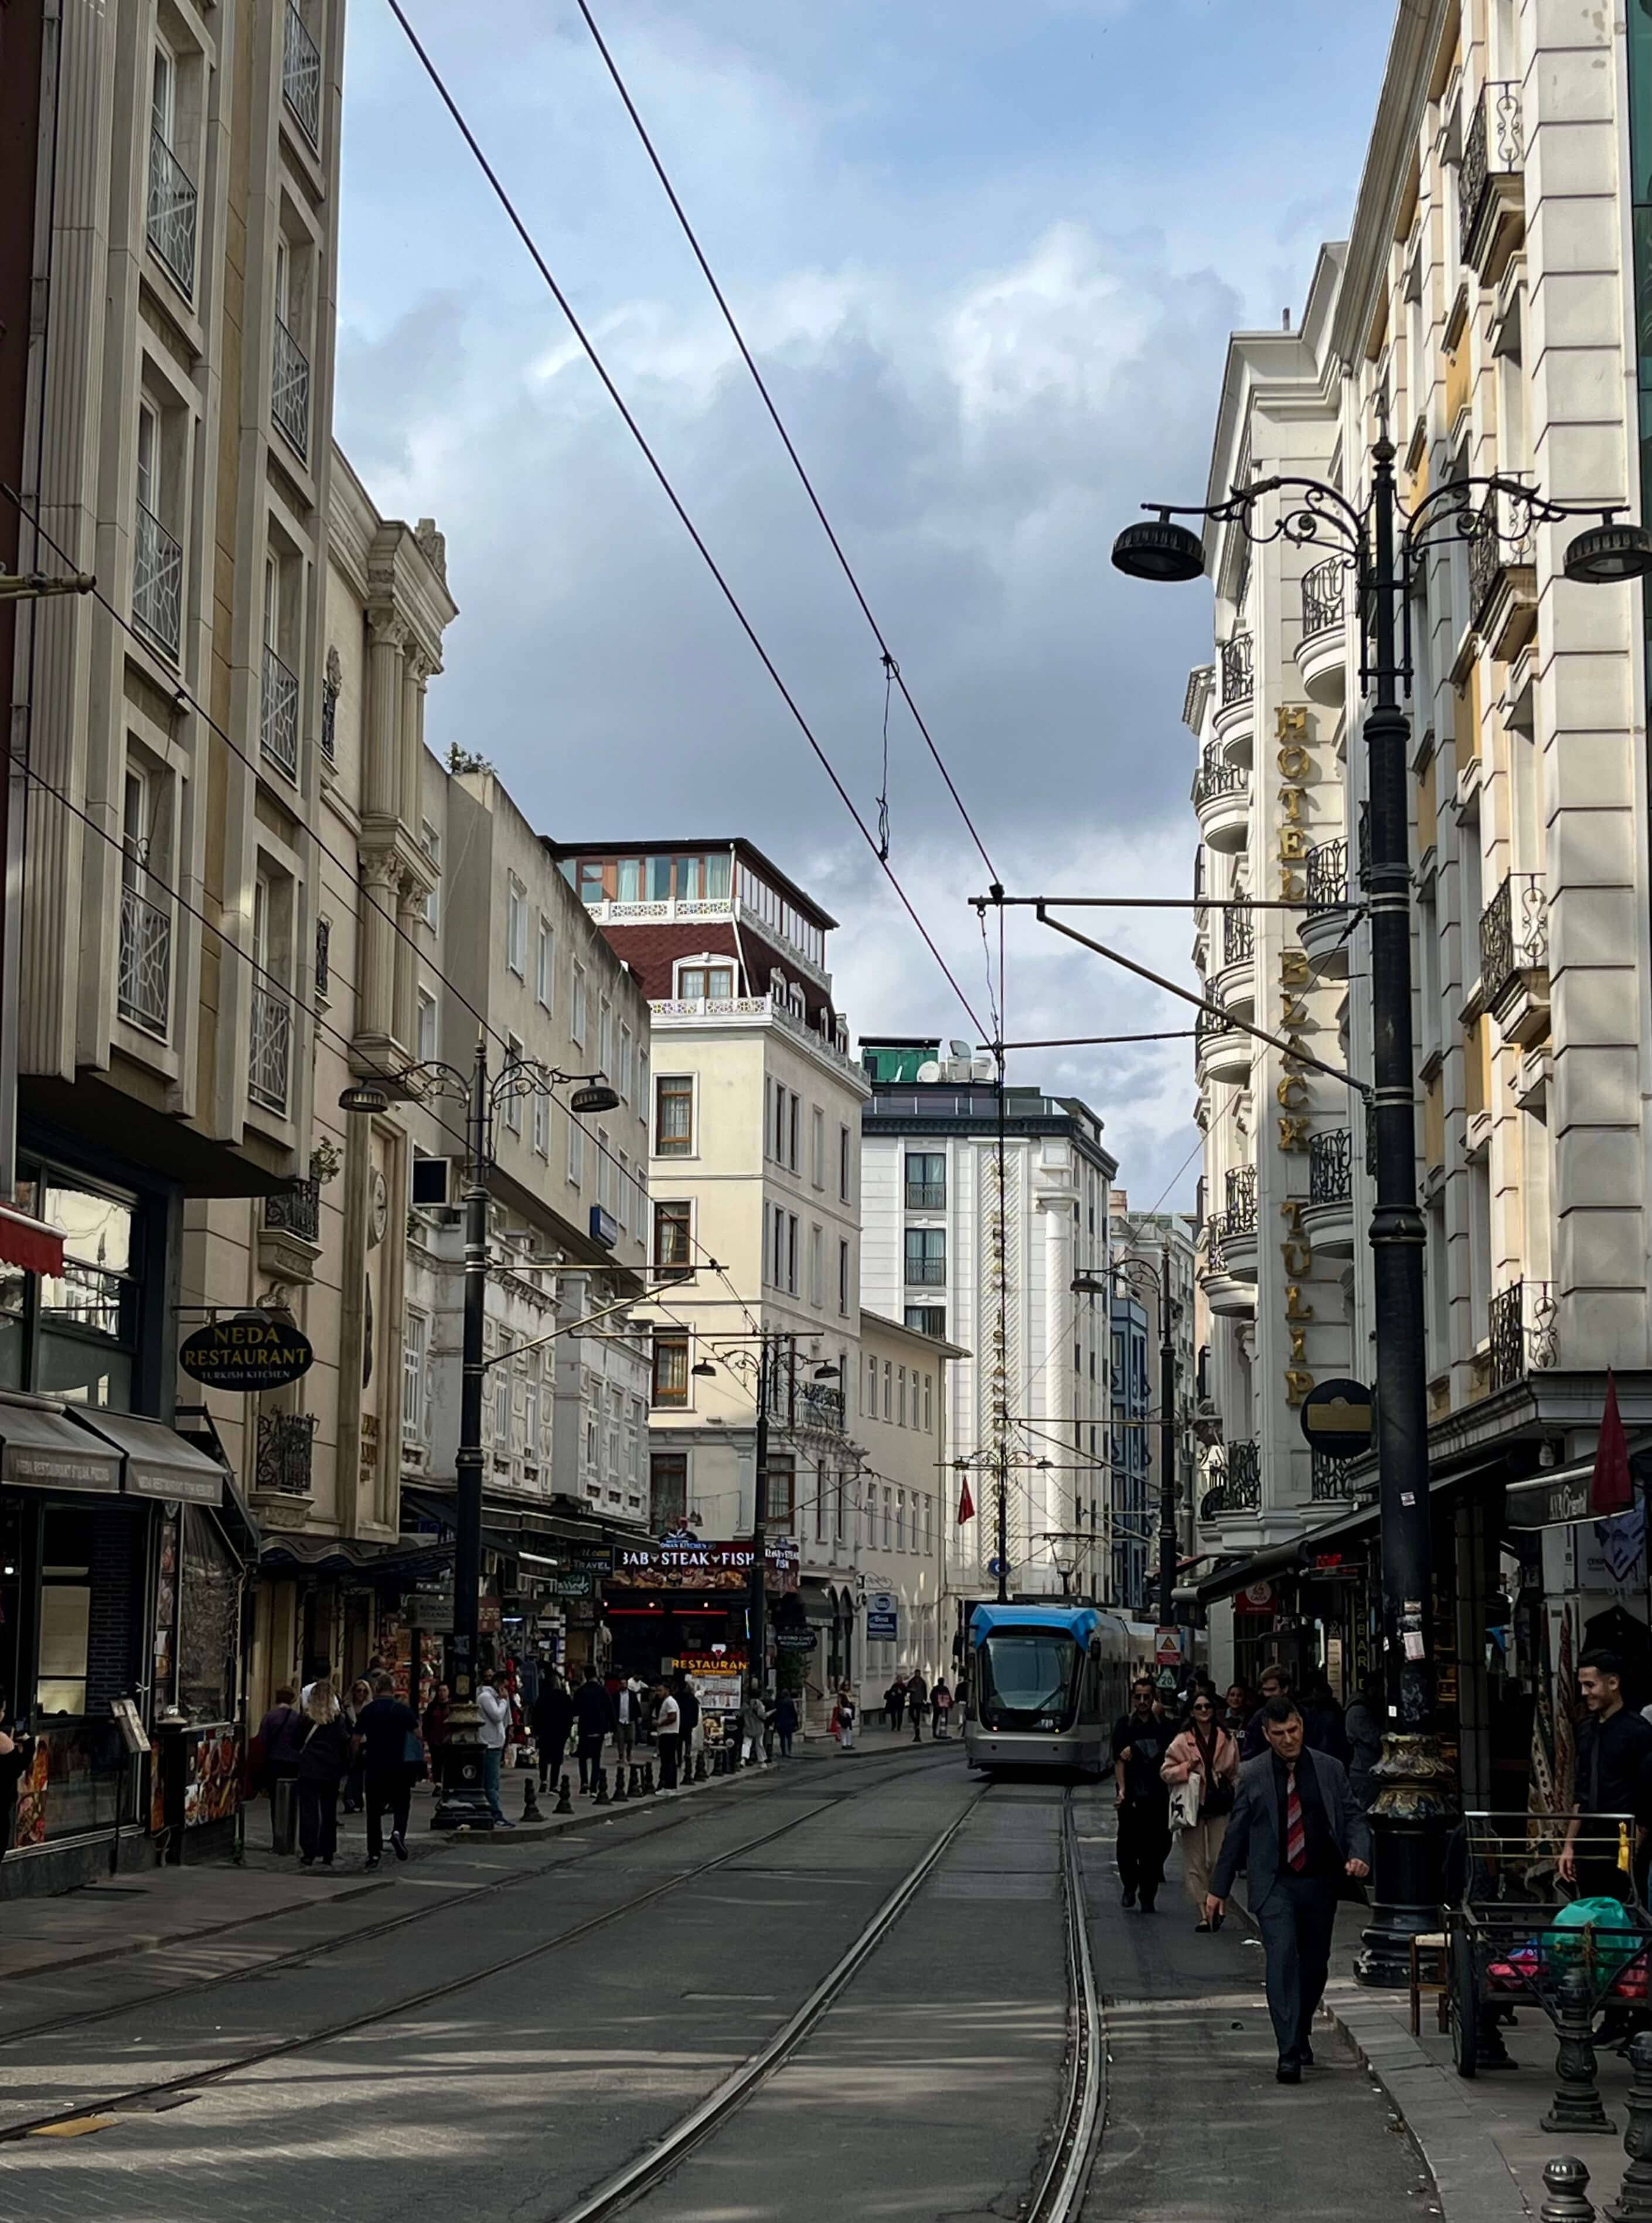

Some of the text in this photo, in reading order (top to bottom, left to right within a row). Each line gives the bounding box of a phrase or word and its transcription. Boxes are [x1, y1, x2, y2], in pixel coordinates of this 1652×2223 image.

[1274, 706, 1311, 902] HOTEL
[1276, 951, 1312, 1152] BLACK
[1280, 1201, 1314, 1405] TULIP
[214, 1326, 281, 1345] NEDA
[185, 1348, 307, 1366] RESTAURANT
[201, 1370, 291, 1380] TURKISH KITCHEN
[573, 1559, 611, 1571] TRAVEL
[661, 1552, 710, 1565] STEAK
[721, 1552, 754, 1565] FISH
[1357, 1624, 1368, 1668] BAR
[1161, 1676, 1173, 1686] 20
